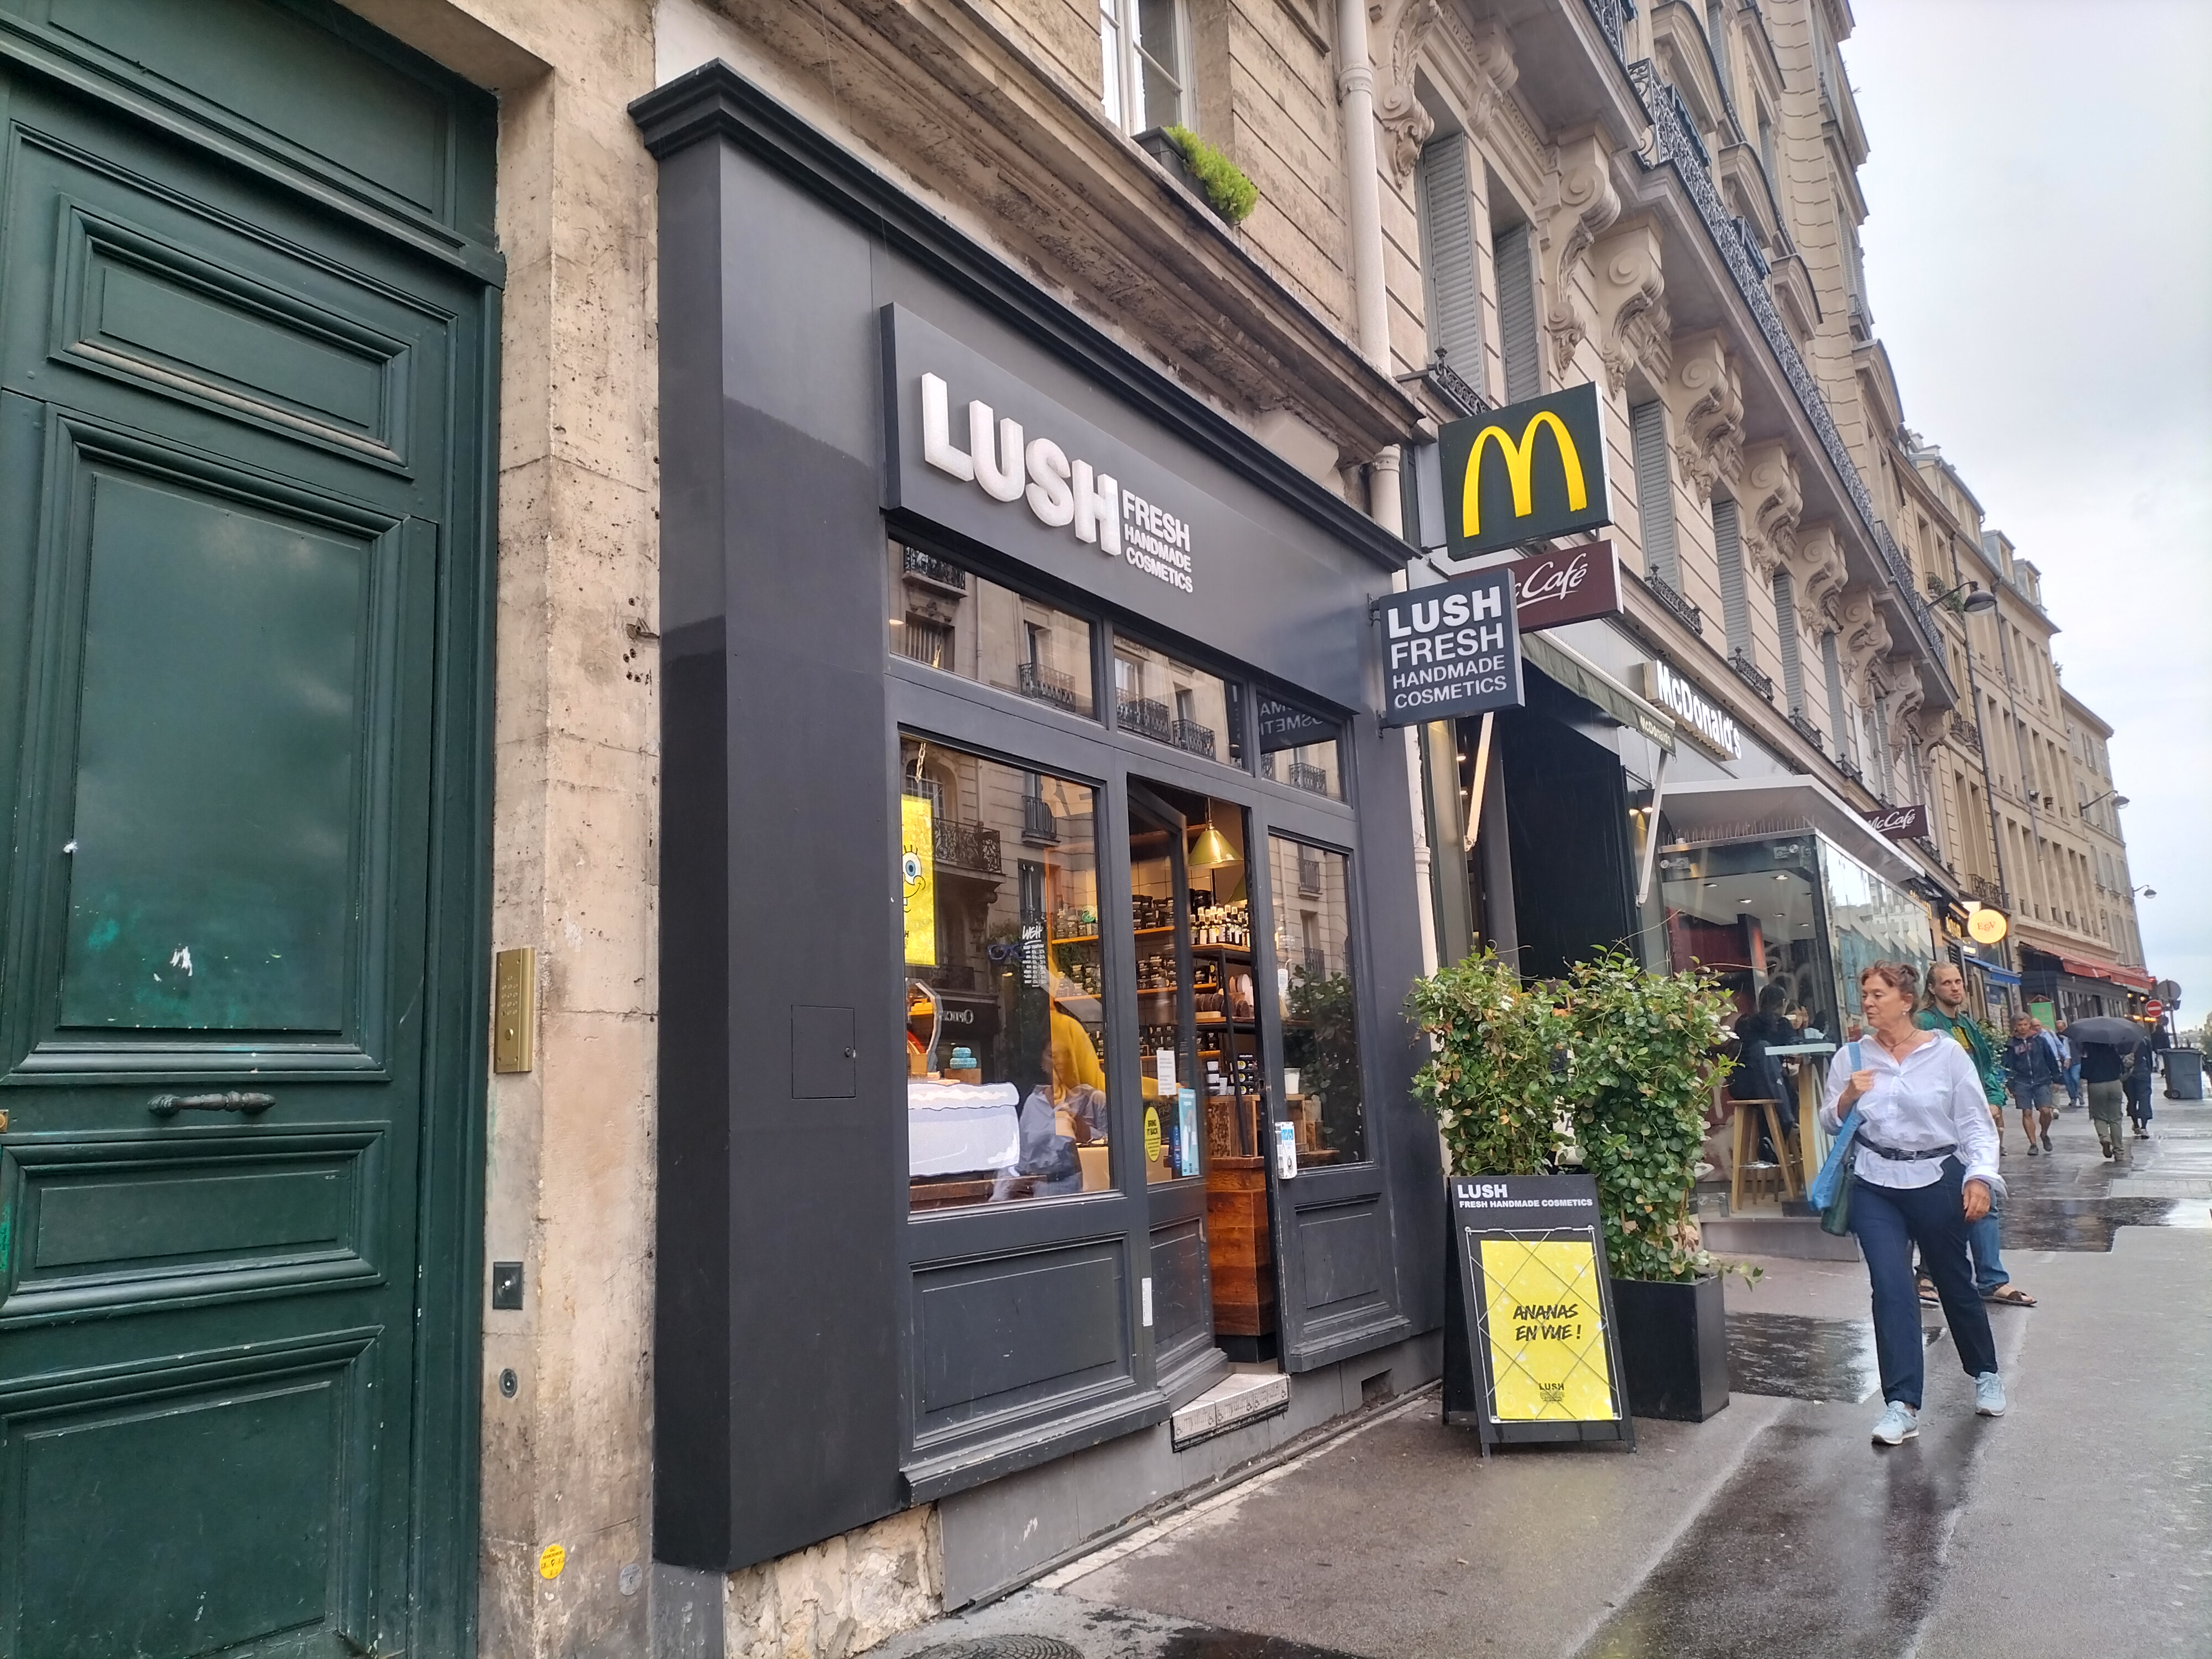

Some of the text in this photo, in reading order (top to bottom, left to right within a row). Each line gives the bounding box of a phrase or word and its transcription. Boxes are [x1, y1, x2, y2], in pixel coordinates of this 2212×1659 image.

[921, 372, 1121, 556] LUSH
[1122, 489, 1190, 552] FRESH
[1124, 523, 1191, 573] HANDMADE
[1126, 547, 1193, 593] COSMETICS
[1515, 552, 1588, 600] cCafé
[1388, 586, 1502, 639] LUSH
[1391, 623, 1504, 670] FRESH
[1392, 654, 1506, 690] HANDMADE
[1394, 675, 1507, 709] COSMETICS
[1657, 660, 1742, 760] McDonald's
[1640, 715, 1672, 747] McDonald's
[1977, 921, 1996, 932] E&V
[1457, 1184, 1508, 1198] LUSH
[1490, 1199, 1540, 1208] HANDMADE
[1542, 1198, 1593, 1207] COSMETICS
[1512, 1303, 1579, 1321] ANANAS
[1515, 1325, 1537, 1342] EN
[1541, 1324, 1573, 1341] VUE
[1539, 1383, 1564, 1391] LUSH
